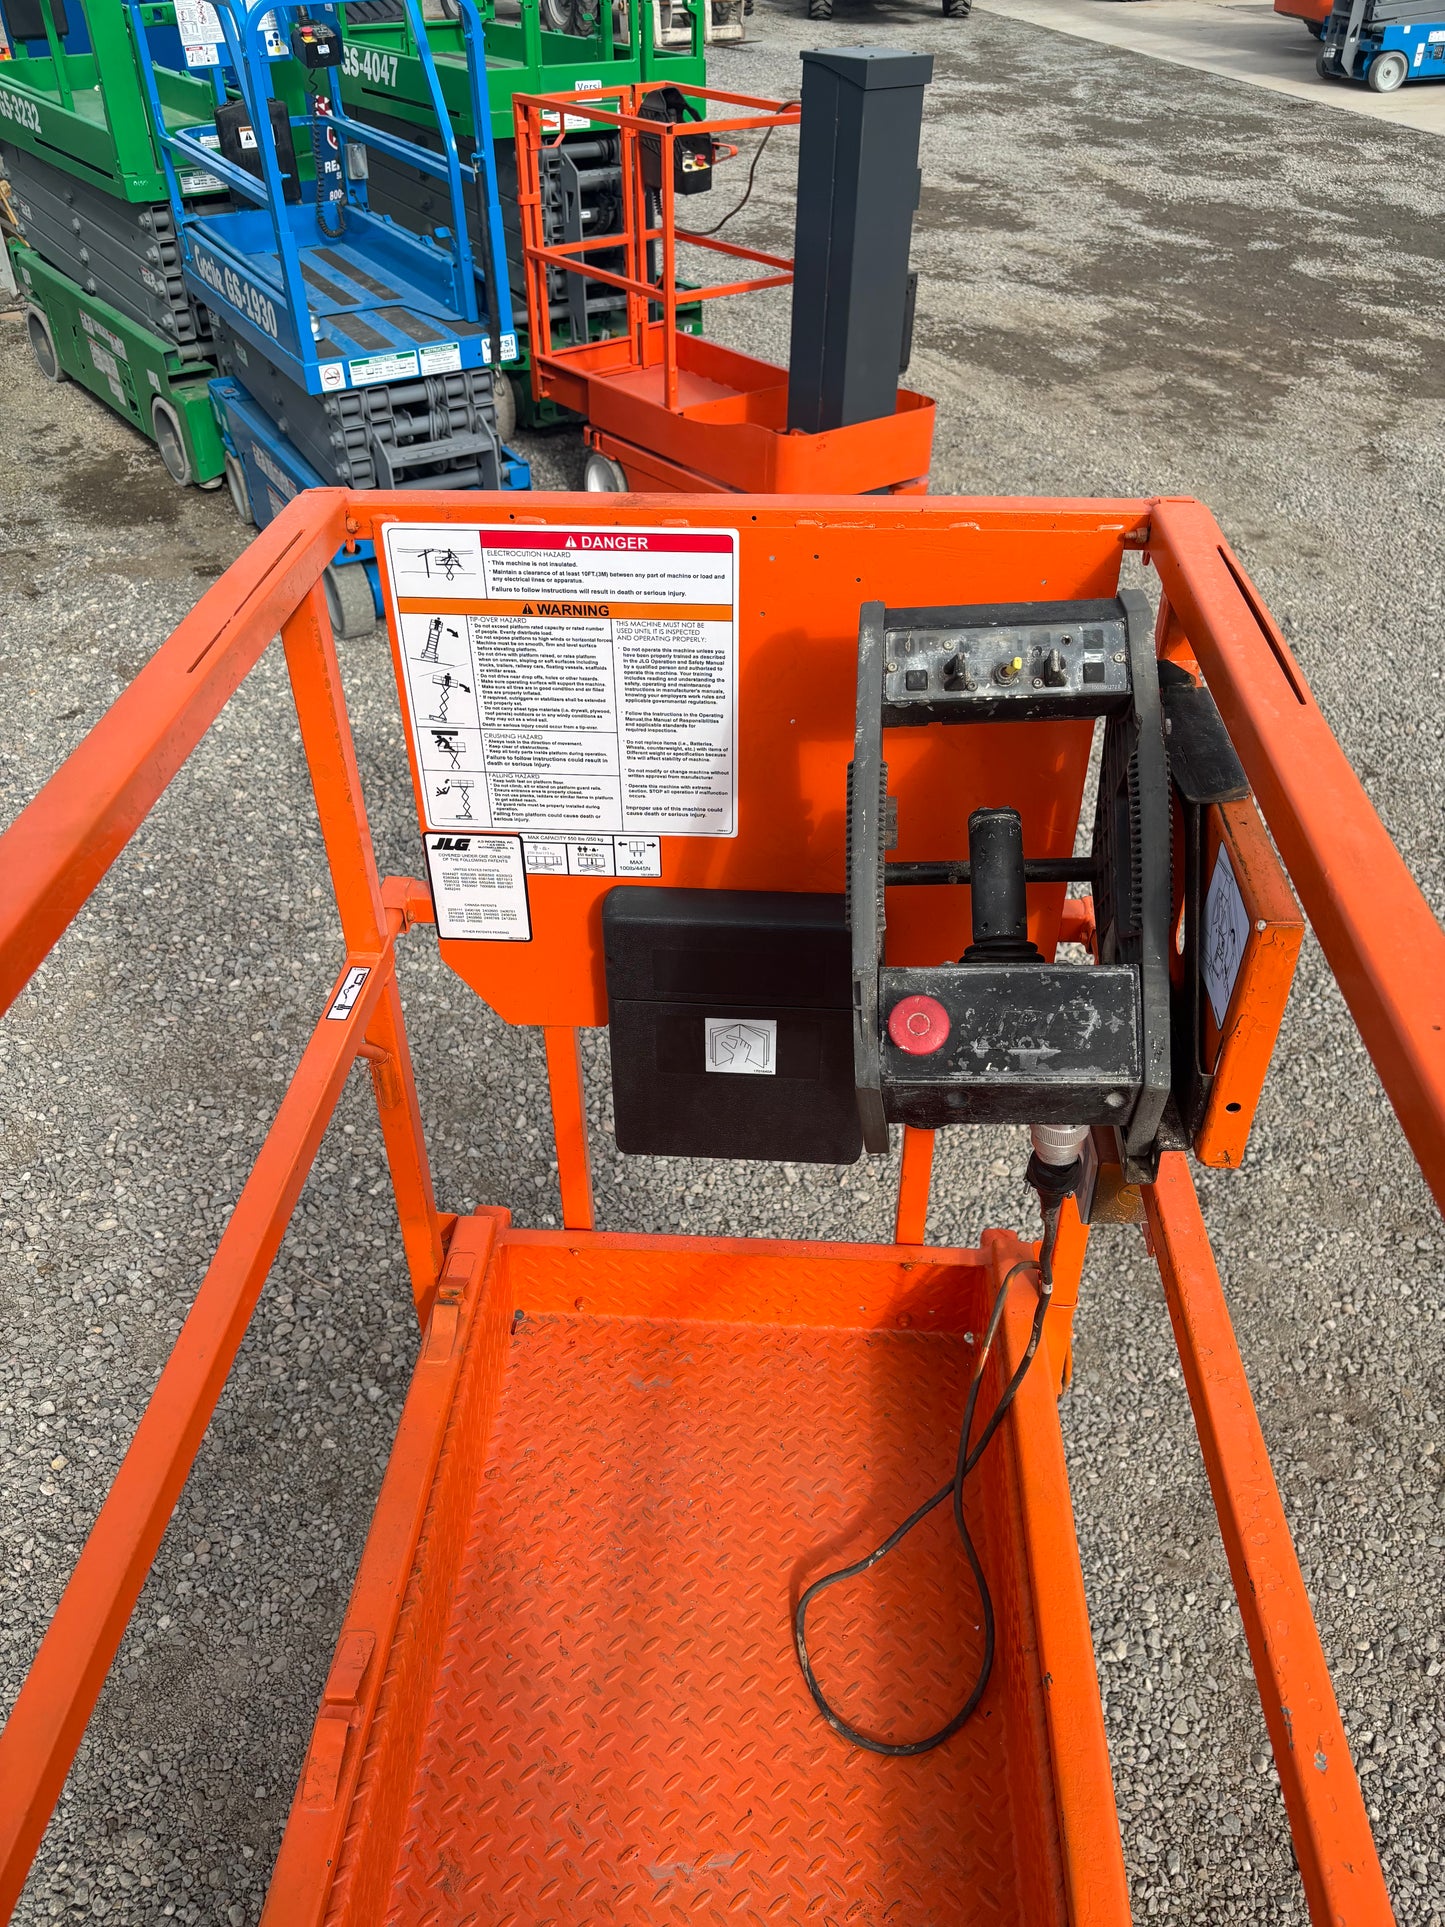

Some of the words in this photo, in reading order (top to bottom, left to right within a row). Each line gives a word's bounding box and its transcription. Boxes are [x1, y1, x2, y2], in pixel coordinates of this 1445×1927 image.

[342, 45, 398, 87] GS-4047
[224, 267, 278, 338] GS-1930
[581, 536, 649, 550] DANGER
[537, 603, 610, 617] WARNING
[431, 837, 471, 851] JLG
